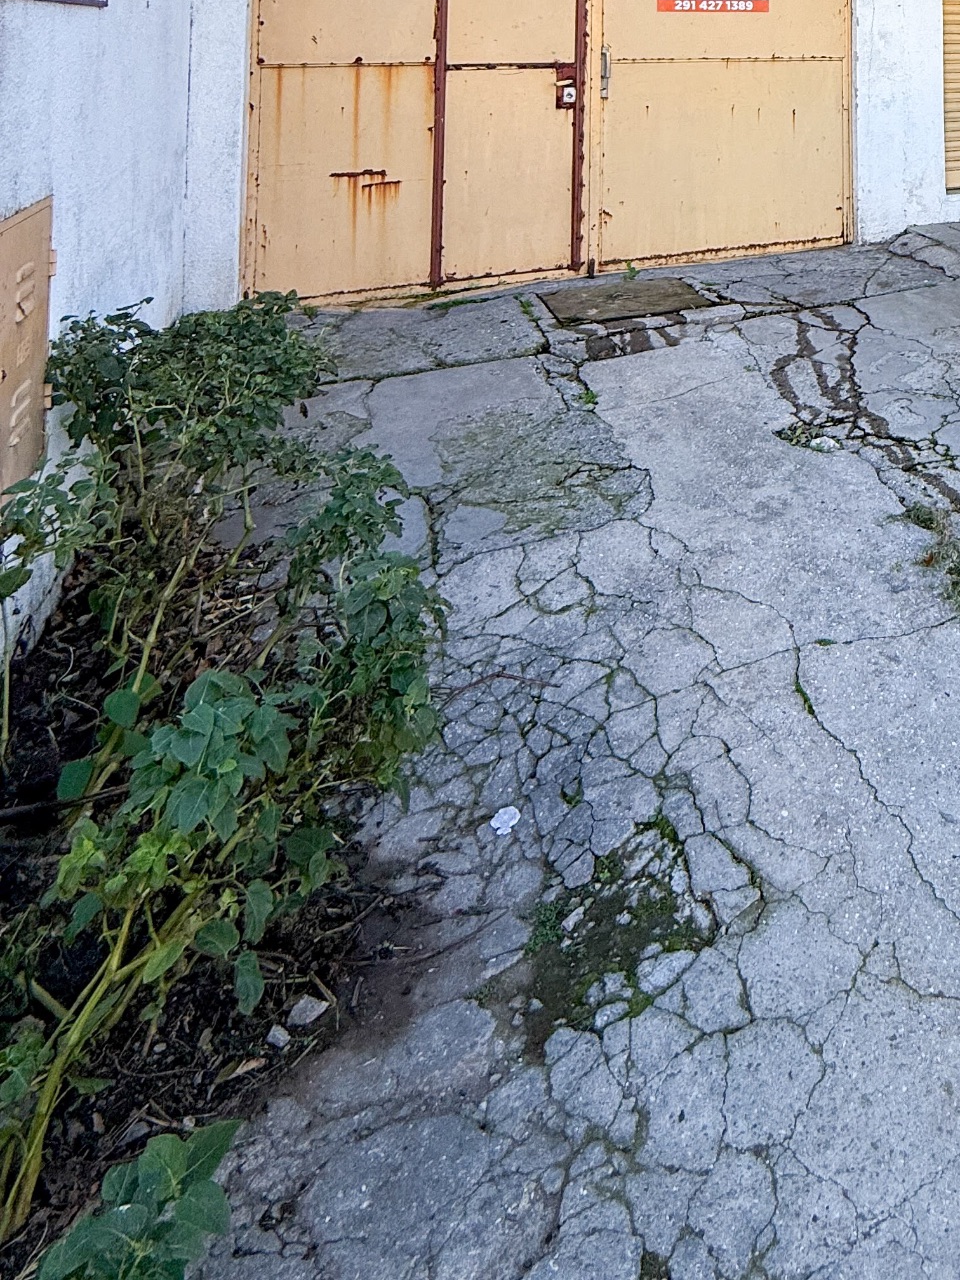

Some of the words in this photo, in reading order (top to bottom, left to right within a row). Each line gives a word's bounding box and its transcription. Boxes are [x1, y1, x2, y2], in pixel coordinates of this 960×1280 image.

[674, 0, 696, 11] 291
[699, 0, 723, 11] 427
[725, 1, 754, 11] 1389
